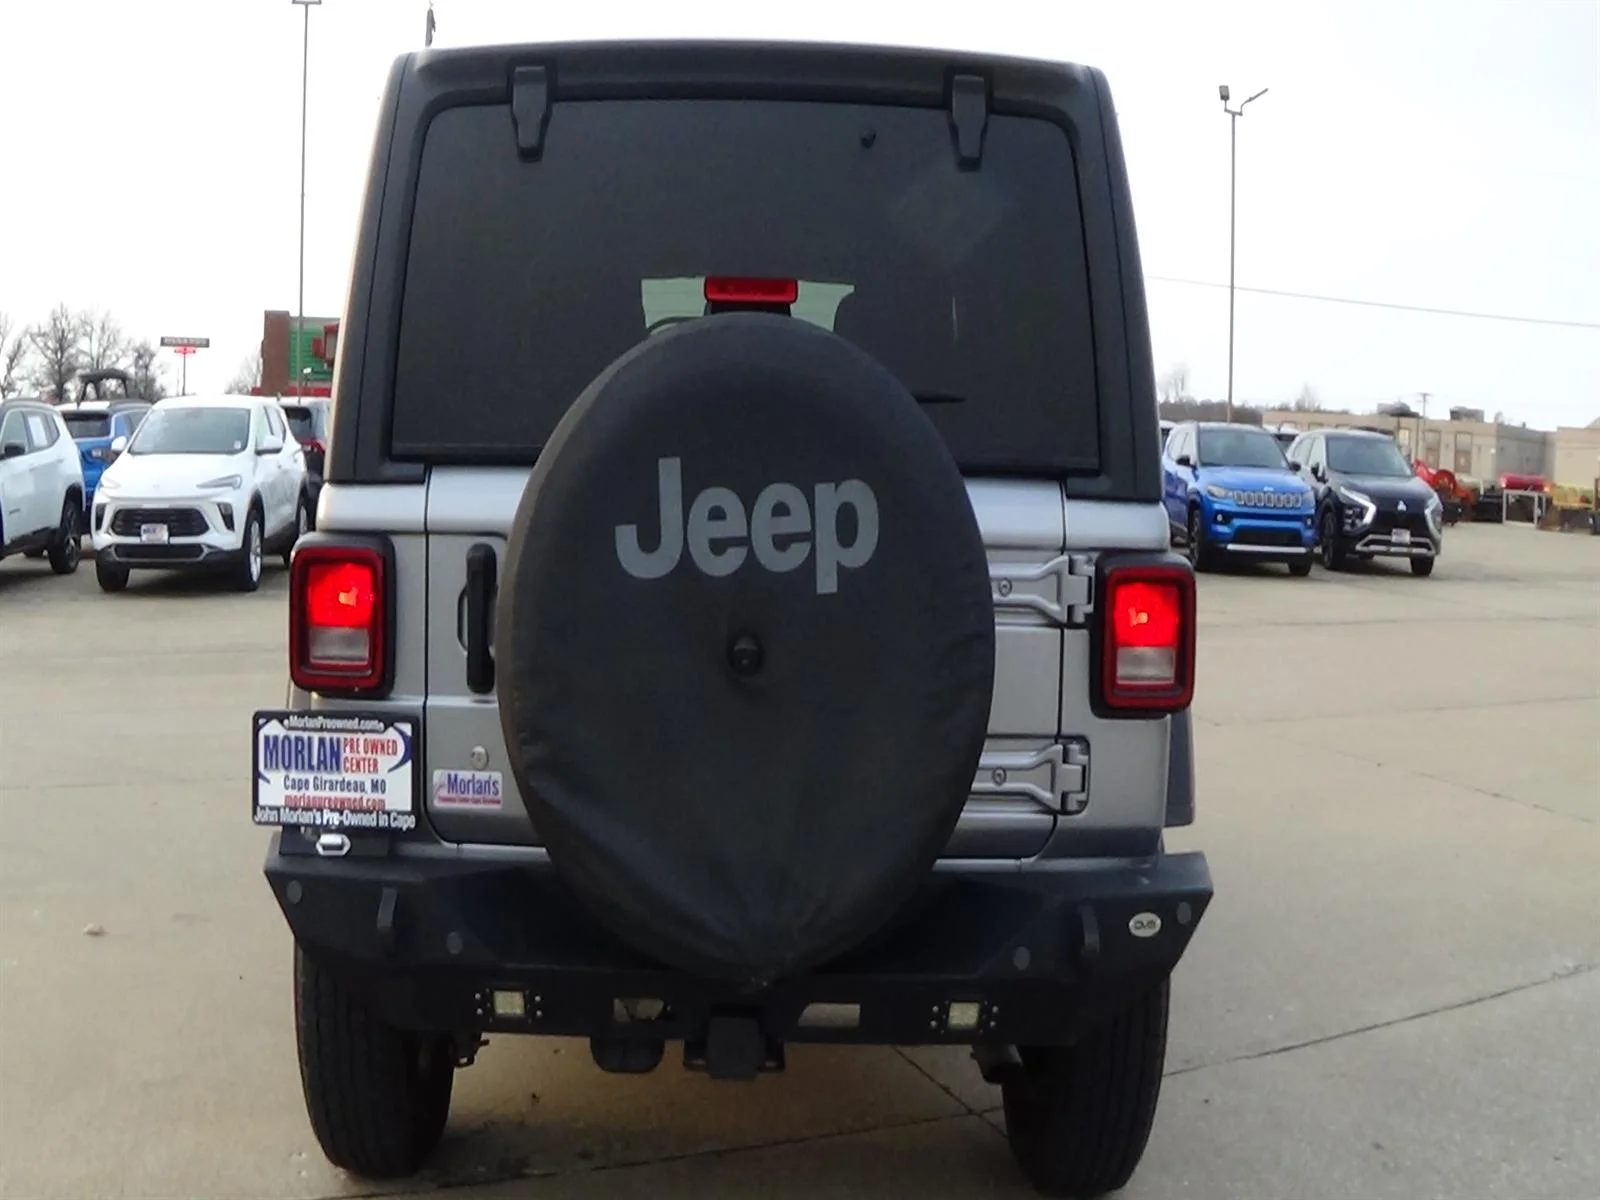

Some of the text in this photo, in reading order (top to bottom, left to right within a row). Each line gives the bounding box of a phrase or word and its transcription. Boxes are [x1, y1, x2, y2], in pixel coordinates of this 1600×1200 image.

[615, 456, 879, 595] Jeep
[264, 735, 341, 771] MORLAN
[343, 737, 398, 756] PRE OWNED
[343, 756, 379, 774] CENTER
[283, 775, 386, 794] Cape Girardeau, MO
[447, 773, 499, 797] Morlan's
[254, 807, 416, 831] John Morlan's Pre-Owned in Cape
